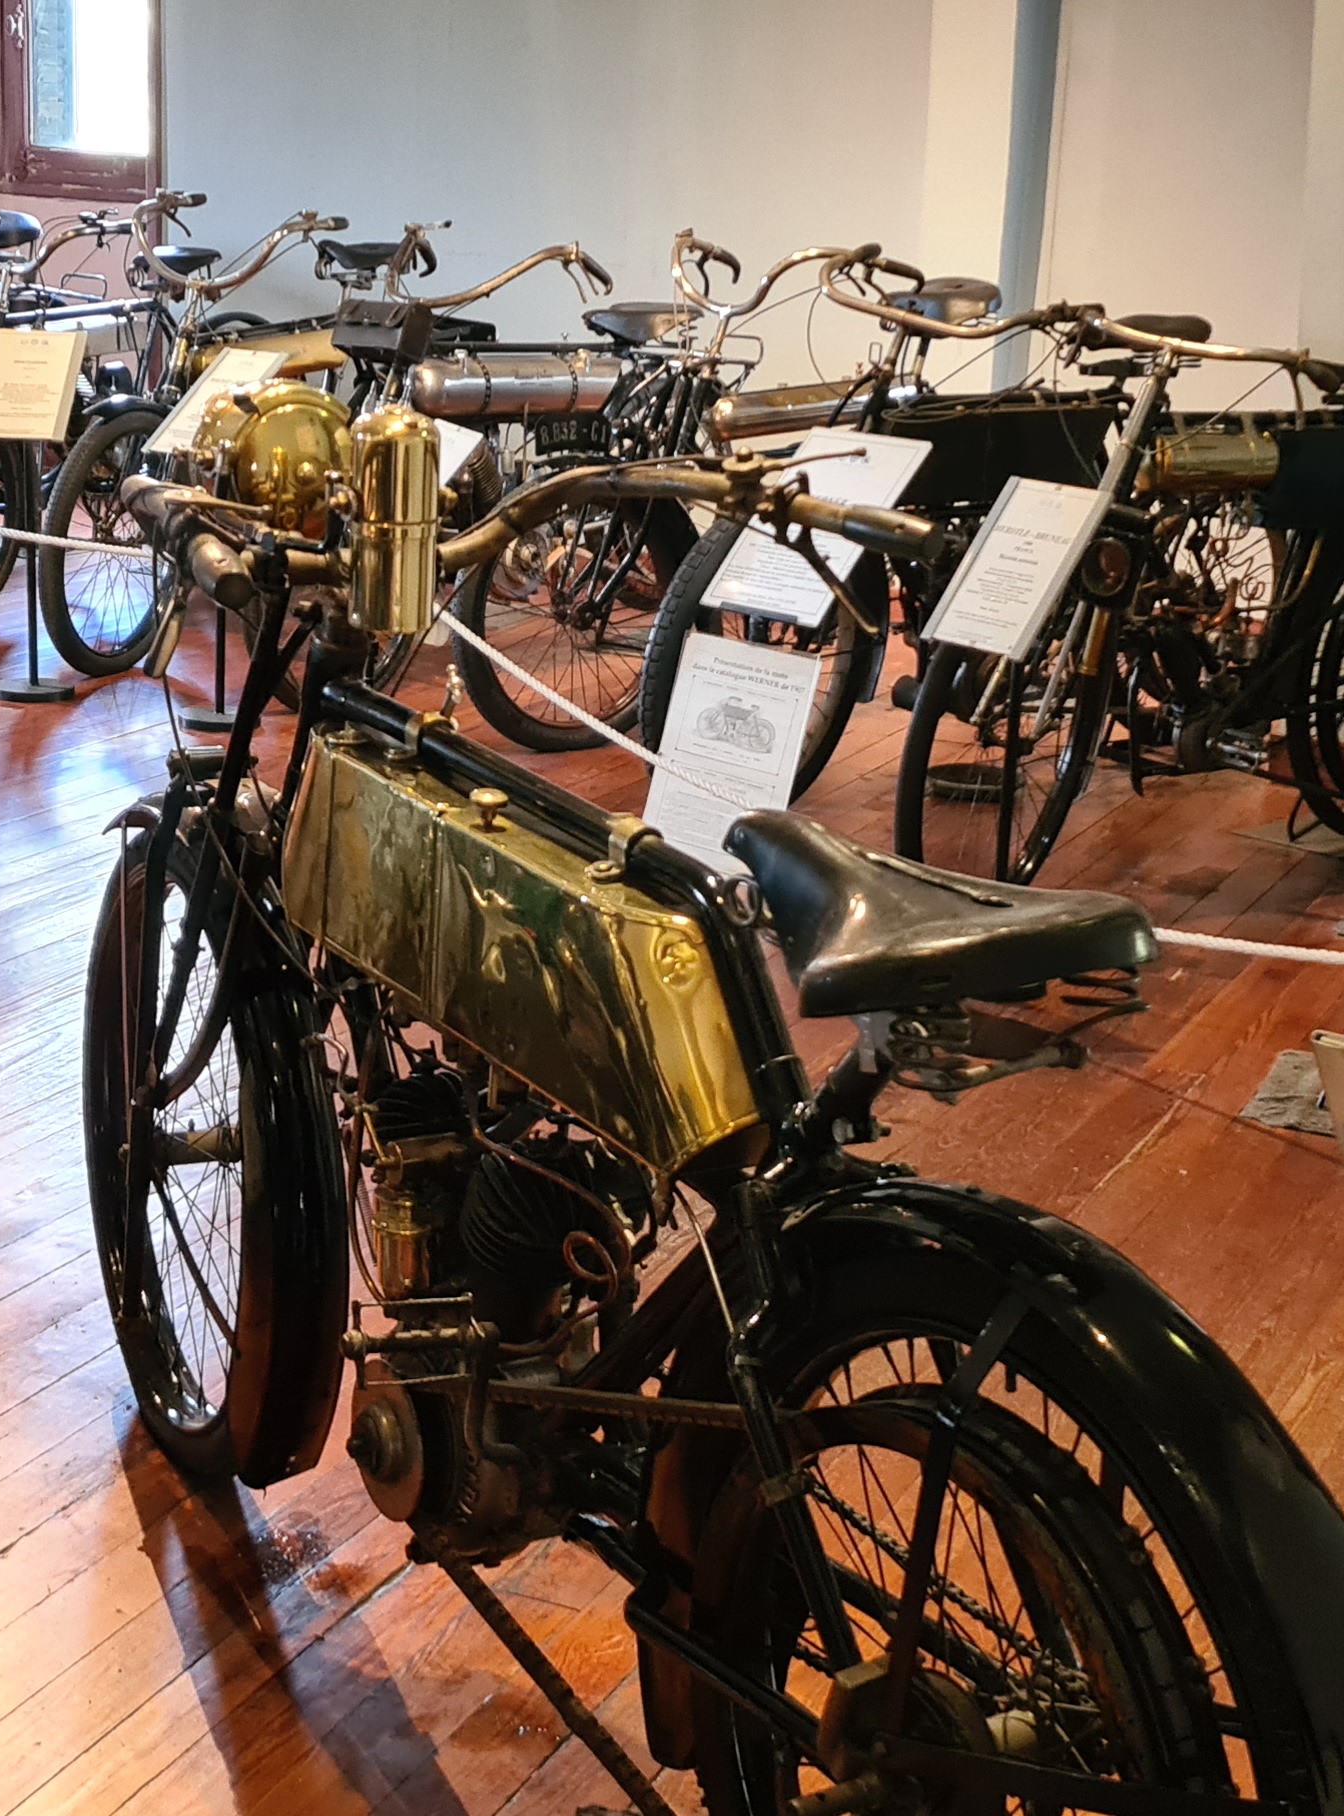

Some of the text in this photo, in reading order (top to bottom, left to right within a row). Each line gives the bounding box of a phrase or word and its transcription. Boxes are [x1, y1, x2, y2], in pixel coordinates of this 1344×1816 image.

[692, 662, 708, 672] dans
[715, 668, 747, 682] catalogue
[747, 674, 780, 689] WERNER
